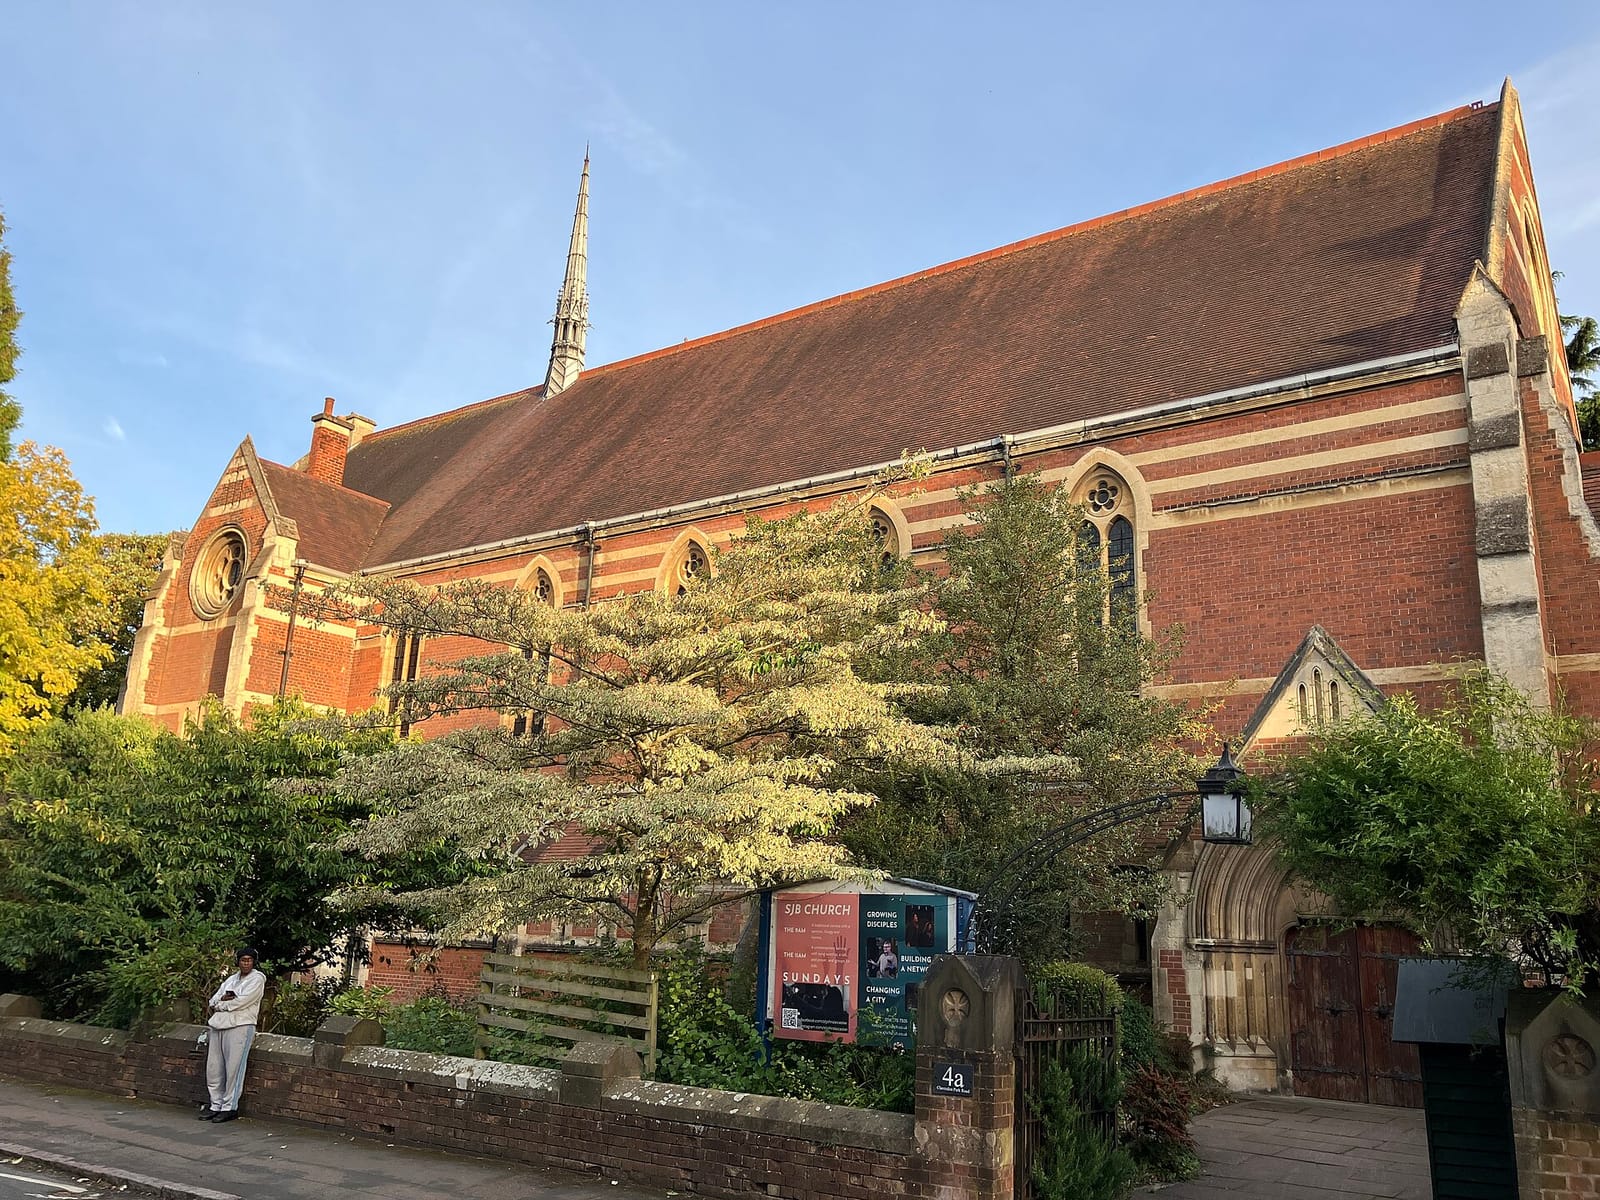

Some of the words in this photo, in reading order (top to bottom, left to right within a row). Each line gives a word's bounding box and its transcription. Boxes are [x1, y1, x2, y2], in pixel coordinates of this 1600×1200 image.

[784, 903, 802, 916] SJB
[804, 903, 851, 916] CHURCH
[866, 911, 898, 919] GROWING
[866, 921, 898, 929] DISCIPLES
[900, 955, 932, 963] BUILDING
[782, 971, 851, 985] SUNDAYS
[866, 986, 900, 995] CHANGING
[871, 996, 886, 1004] CITY
[942, 1066, 965, 1088] 4a
